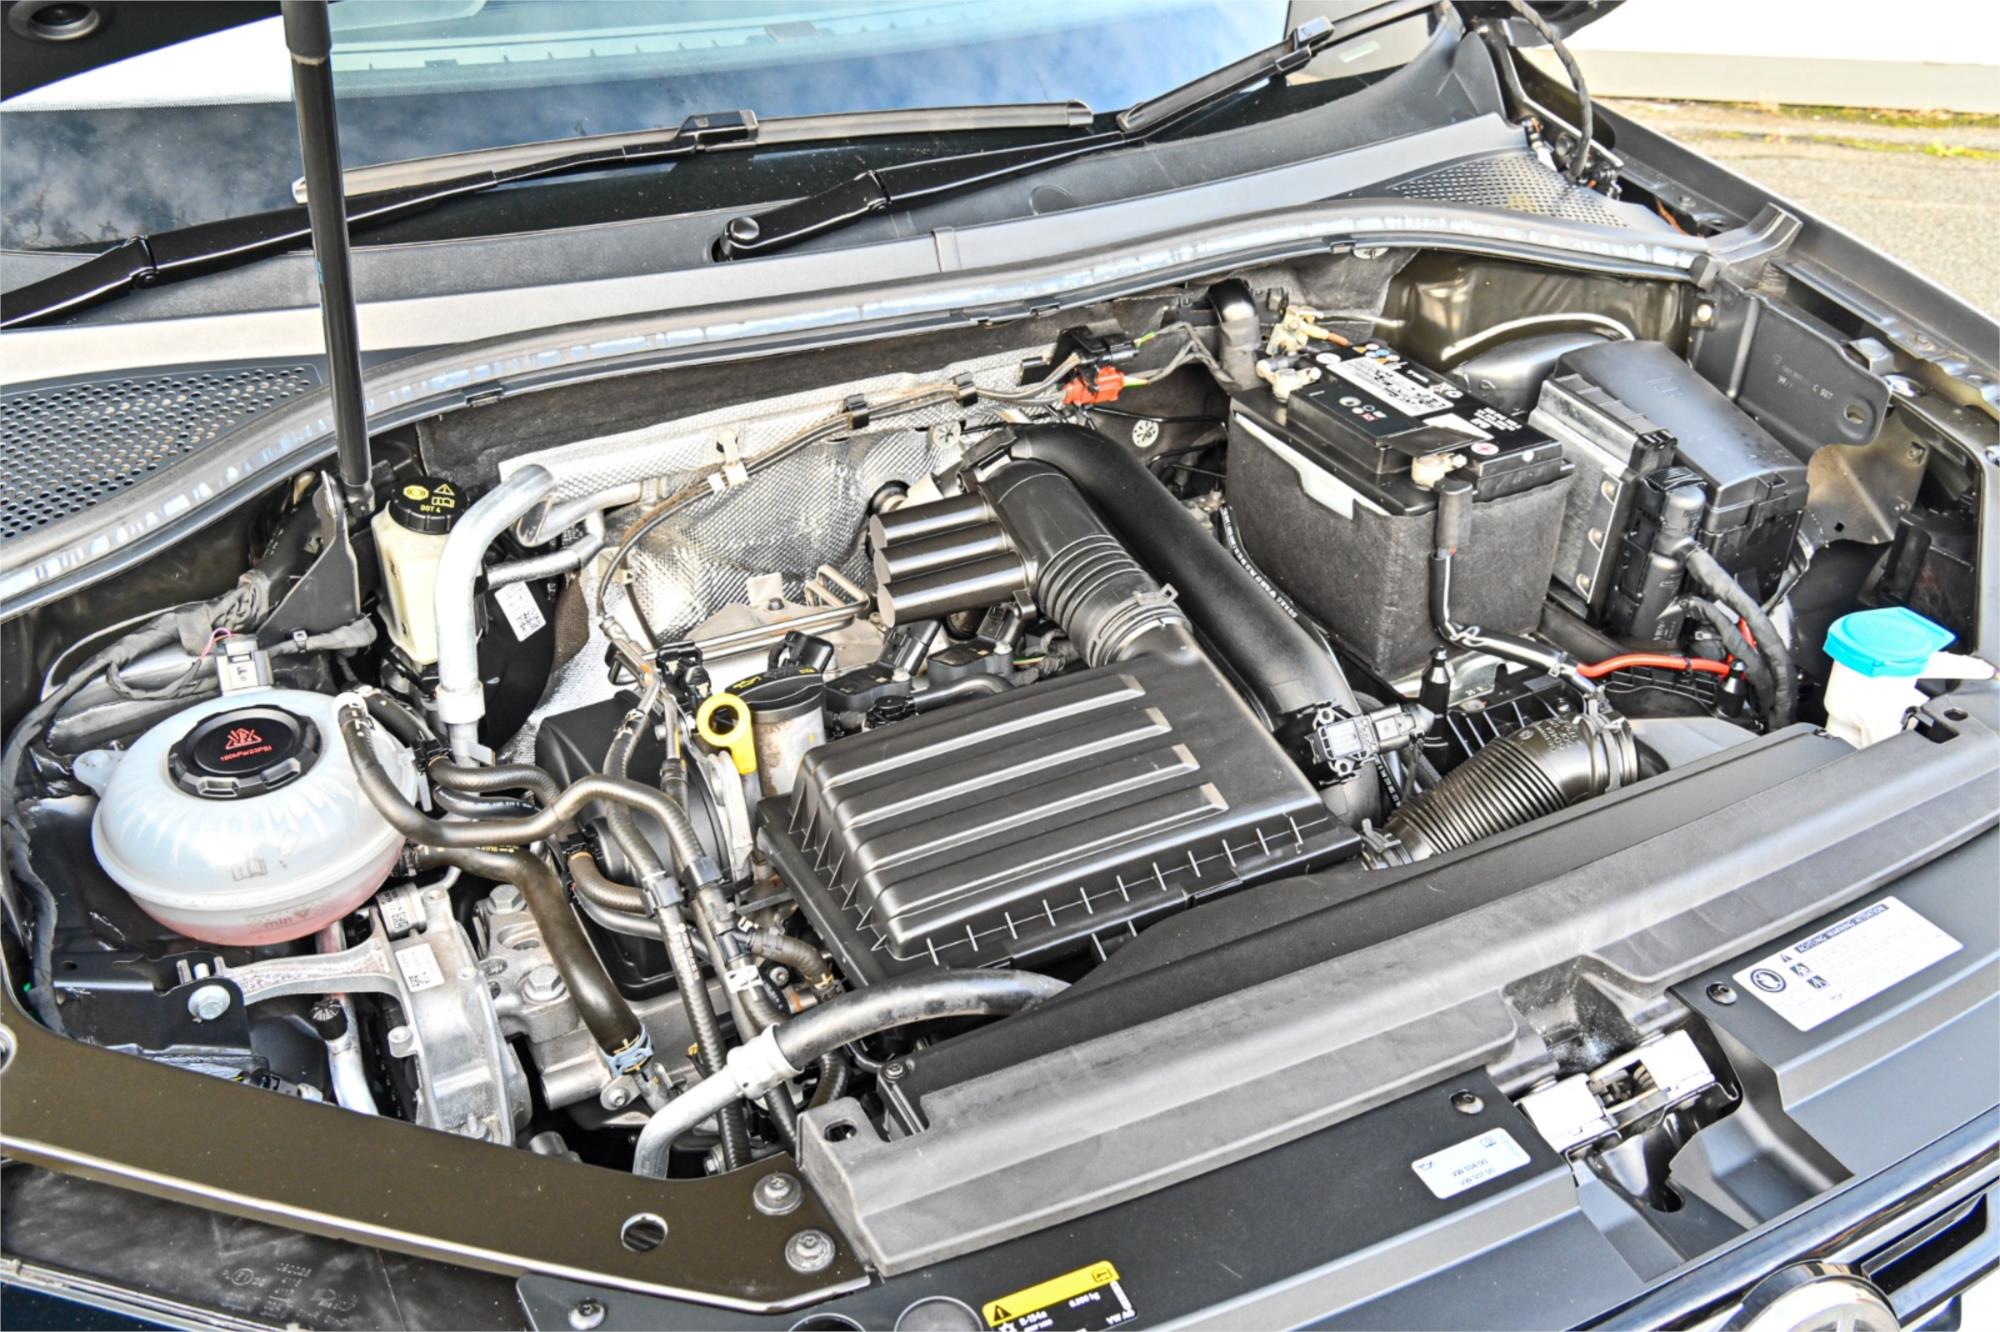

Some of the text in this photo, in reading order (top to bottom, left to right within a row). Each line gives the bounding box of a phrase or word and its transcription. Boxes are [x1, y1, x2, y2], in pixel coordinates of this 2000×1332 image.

[420, 504, 435, 513] DOT
[264, 916, 293, 929] min
[1828, 919, 1855, 938] WARNING
[1856, 904, 1886, 922] ATTENTION
